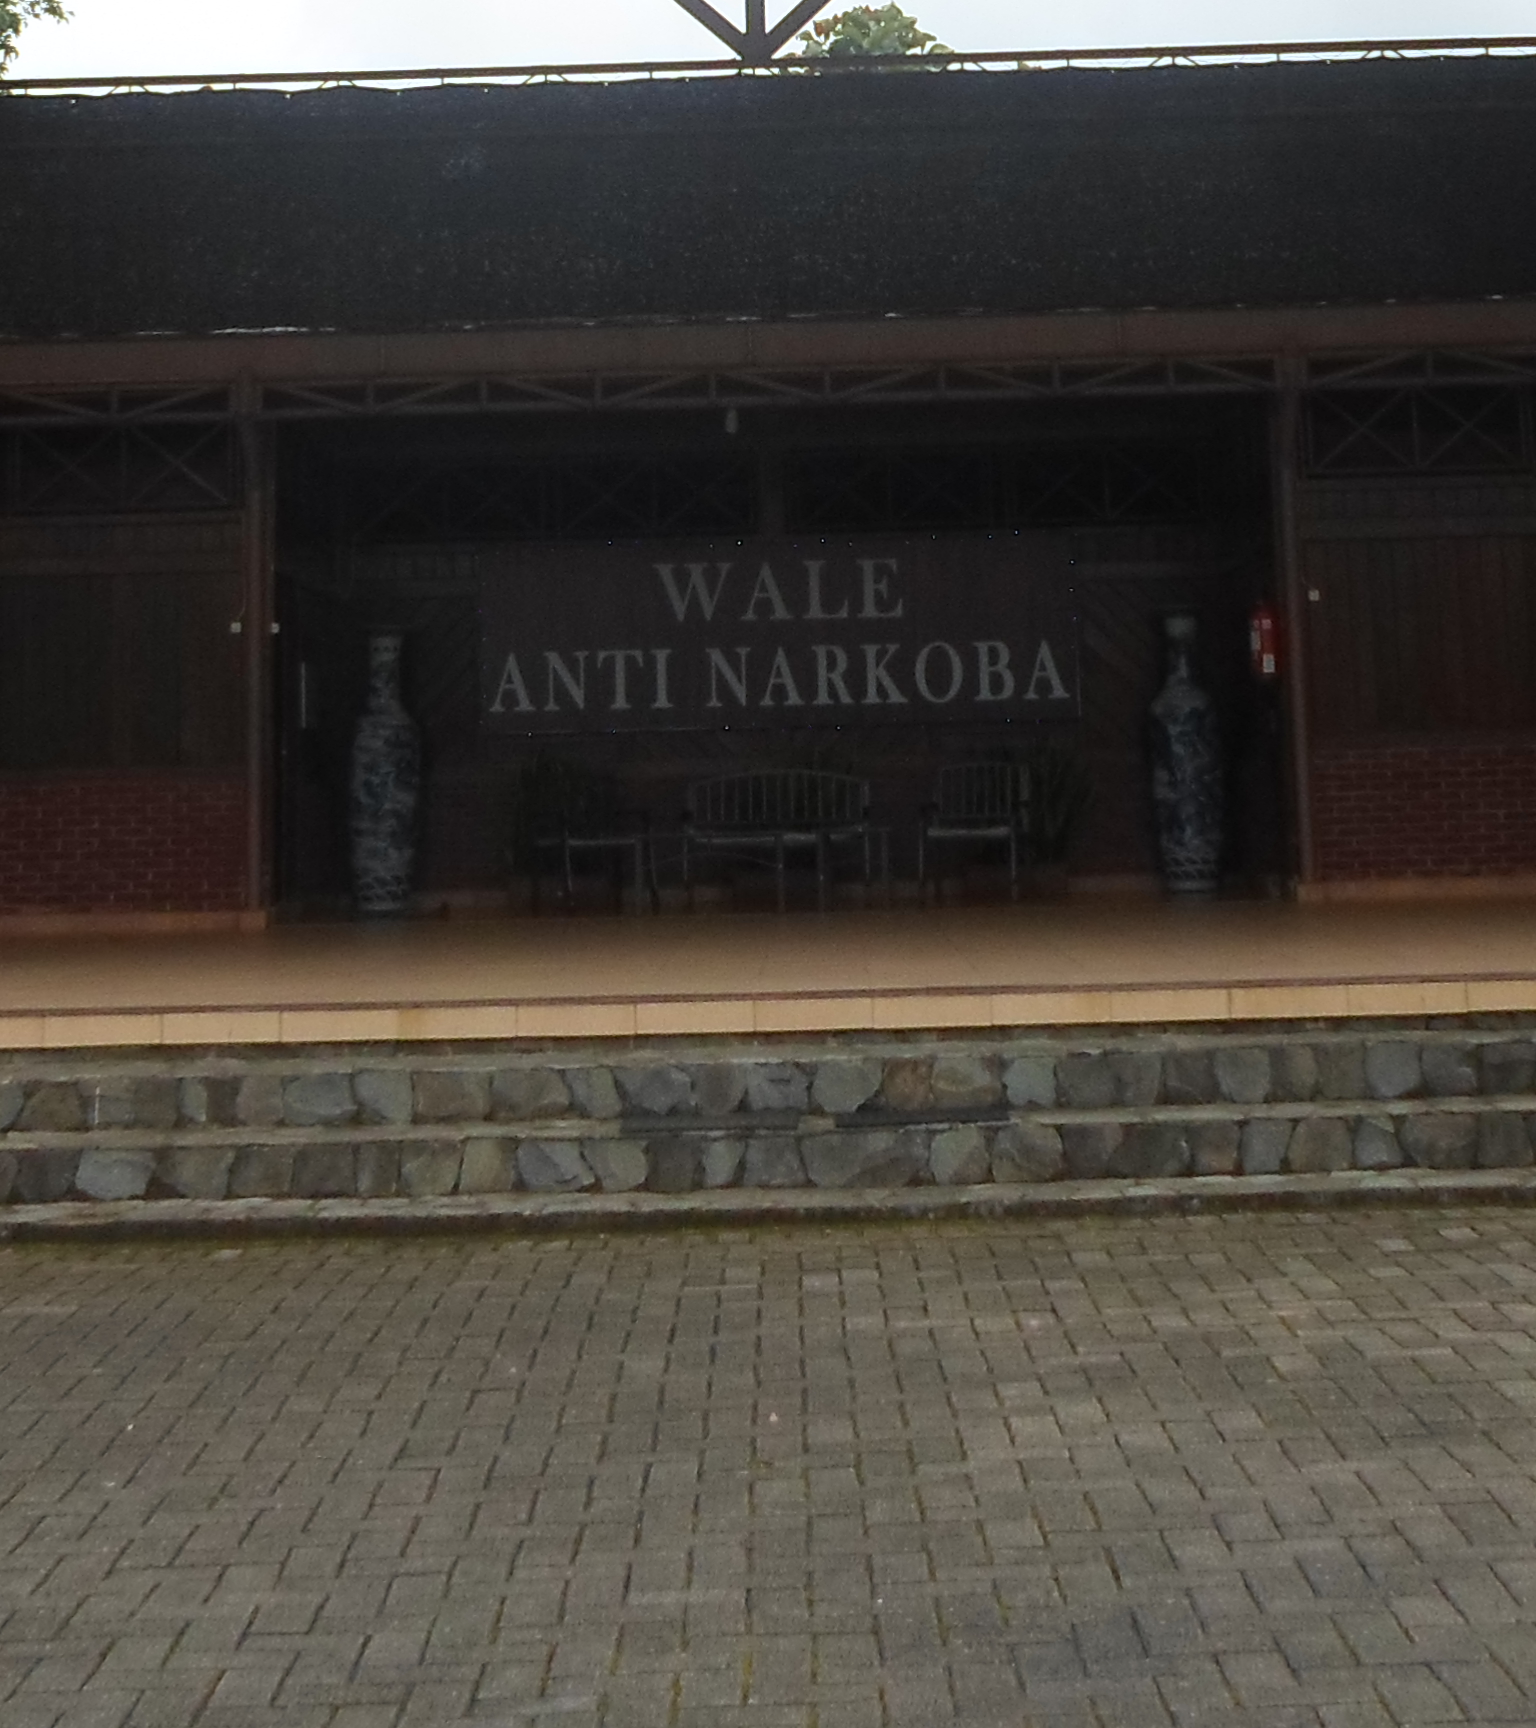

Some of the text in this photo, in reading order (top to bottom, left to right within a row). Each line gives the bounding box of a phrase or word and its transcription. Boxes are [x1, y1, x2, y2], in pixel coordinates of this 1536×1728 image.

[652, 558, 905, 623] WALE
[489, 639, 1071, 713] ANTI NARKOBA
